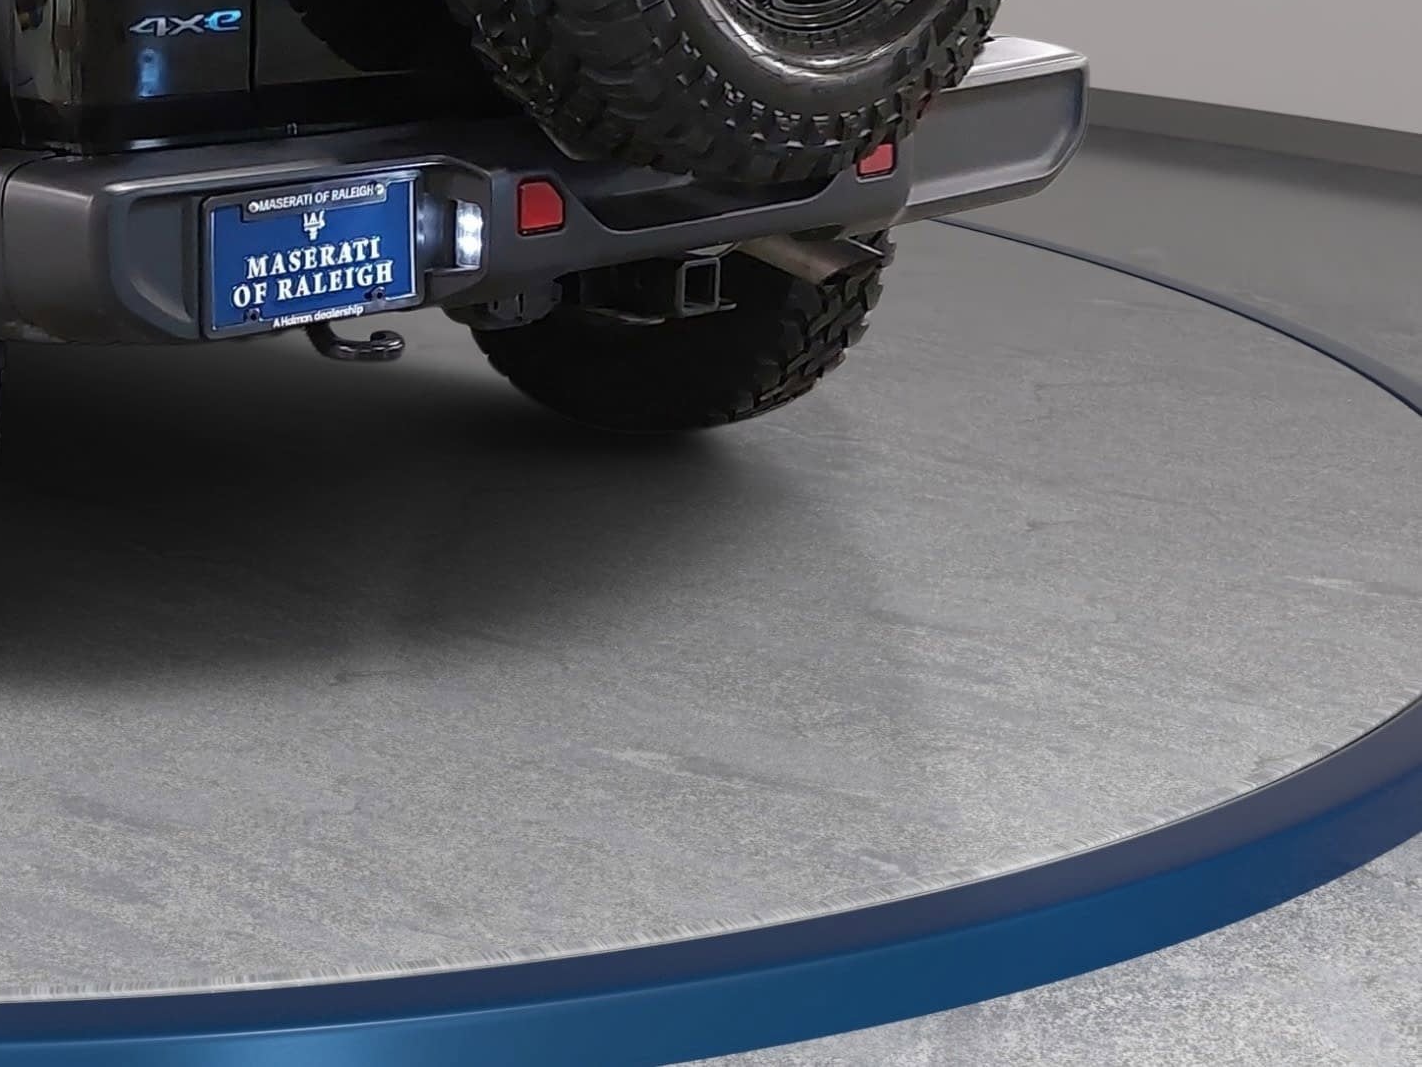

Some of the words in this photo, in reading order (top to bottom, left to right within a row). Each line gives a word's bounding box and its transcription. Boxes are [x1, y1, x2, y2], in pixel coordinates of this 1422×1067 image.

[258, 194, 313, 211] MASERATI
[314, 191, 329, 203] OF
[331, 184, 374, 201] RALEIGH
[246, 236, 381, 279] MASERATI
[233, 282, 267, 308] OF
[277, 260, 393, 300] RALEIGH
[273, 319, 280, 328] A
[314, 305, 364, 321] dealership
